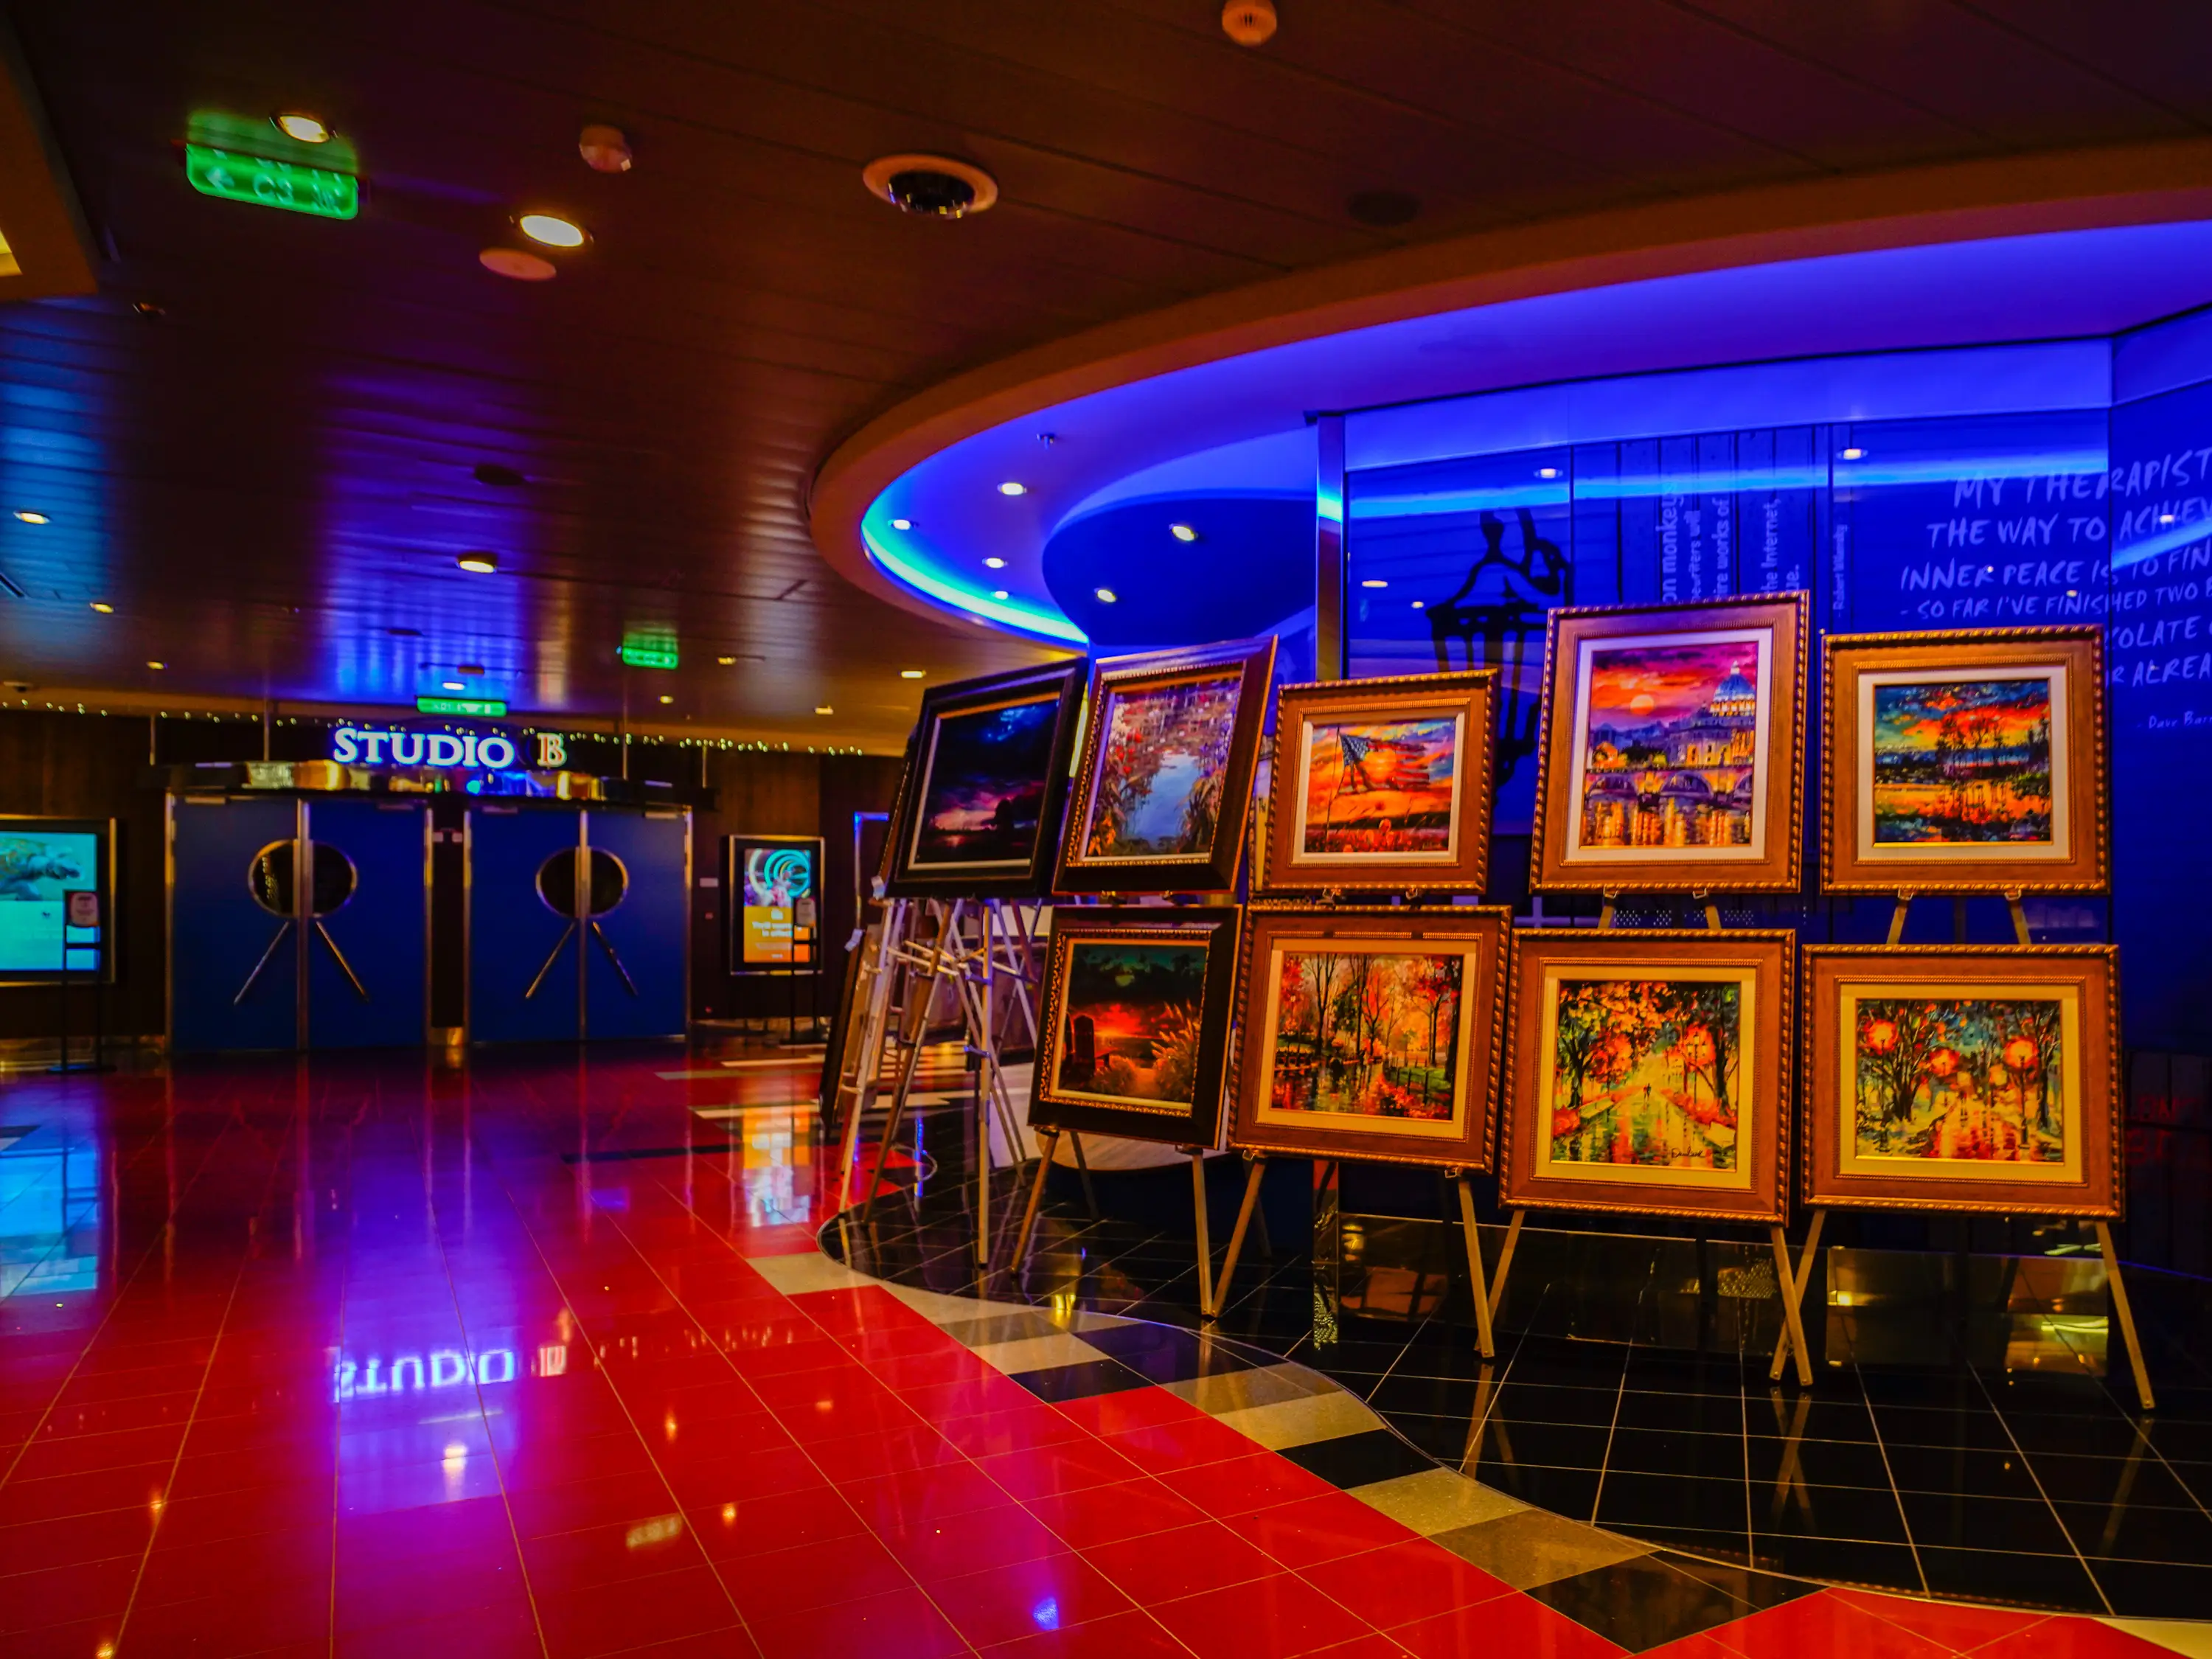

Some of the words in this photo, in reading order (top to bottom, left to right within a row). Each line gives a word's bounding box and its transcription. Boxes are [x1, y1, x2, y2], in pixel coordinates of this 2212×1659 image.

[1954, 471, 2008, 509] MY
[2025, 447, 2212, 504] THERAPIST
[1712, 497, 1729, 517] of
[1711, 520, 1729, 569] works
[1760, 498, 1781, 568] Internet,
[1926, 517, 1991, 548] THE
[1997, 512, 2059, 547] WAY
[2067, 515, 2107, 543] TO
[1900, 557, 1994, 591] INNER
[2003, 560, 2085, 588] PEACE
[2091, 559, 2118, 586] IS
[1917, 599, 1944, 619] SO
[1952, 597, 1990, 619] FAR
[1996, 594, 2040, 617] I'VE
[2045, 589, 2147, 616] FINISHED
[2154, 582, 2199, 606] TWO
[2132, 652, 2211, 687] ALREA
[334, 726, 515, 768] STUDIO
[536, 732, 568, 768] B
